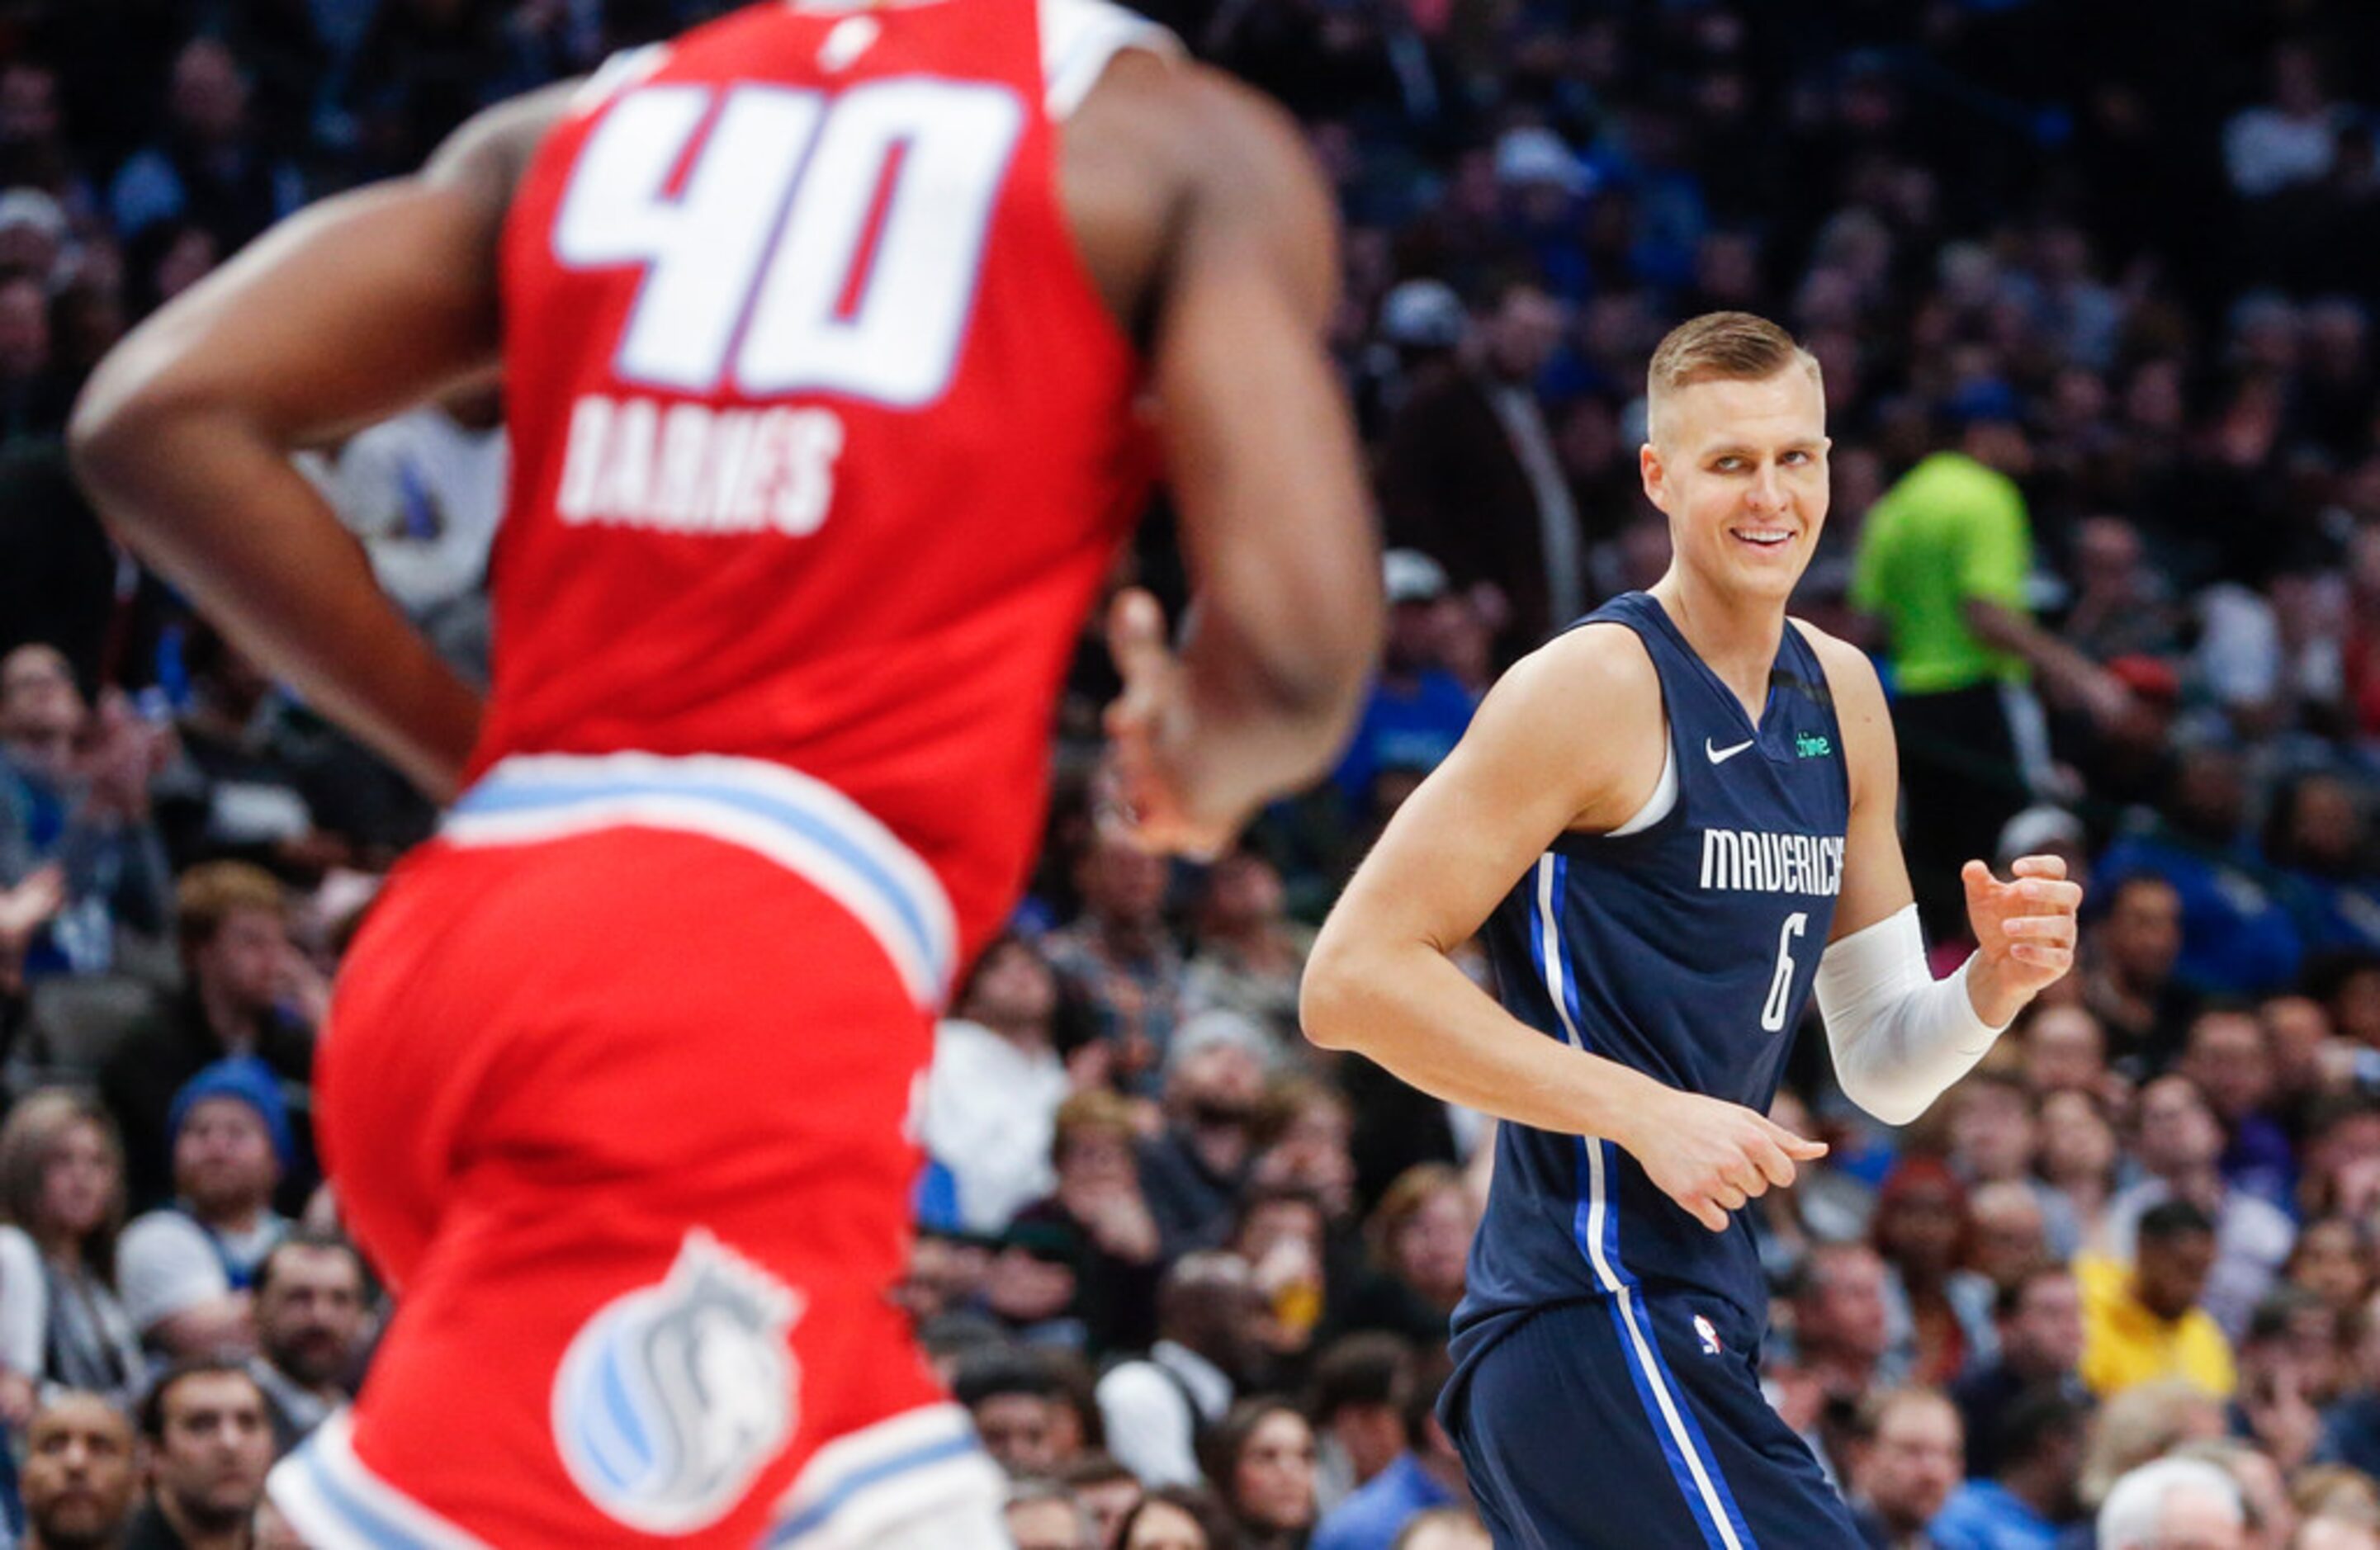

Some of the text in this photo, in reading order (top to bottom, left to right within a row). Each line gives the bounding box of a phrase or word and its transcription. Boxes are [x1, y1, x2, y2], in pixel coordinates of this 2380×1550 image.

[551, 76, 1026, 411] 40
[556, 394, 845, 536] BARNES
[1761, 912, 1808, 1031] 6
